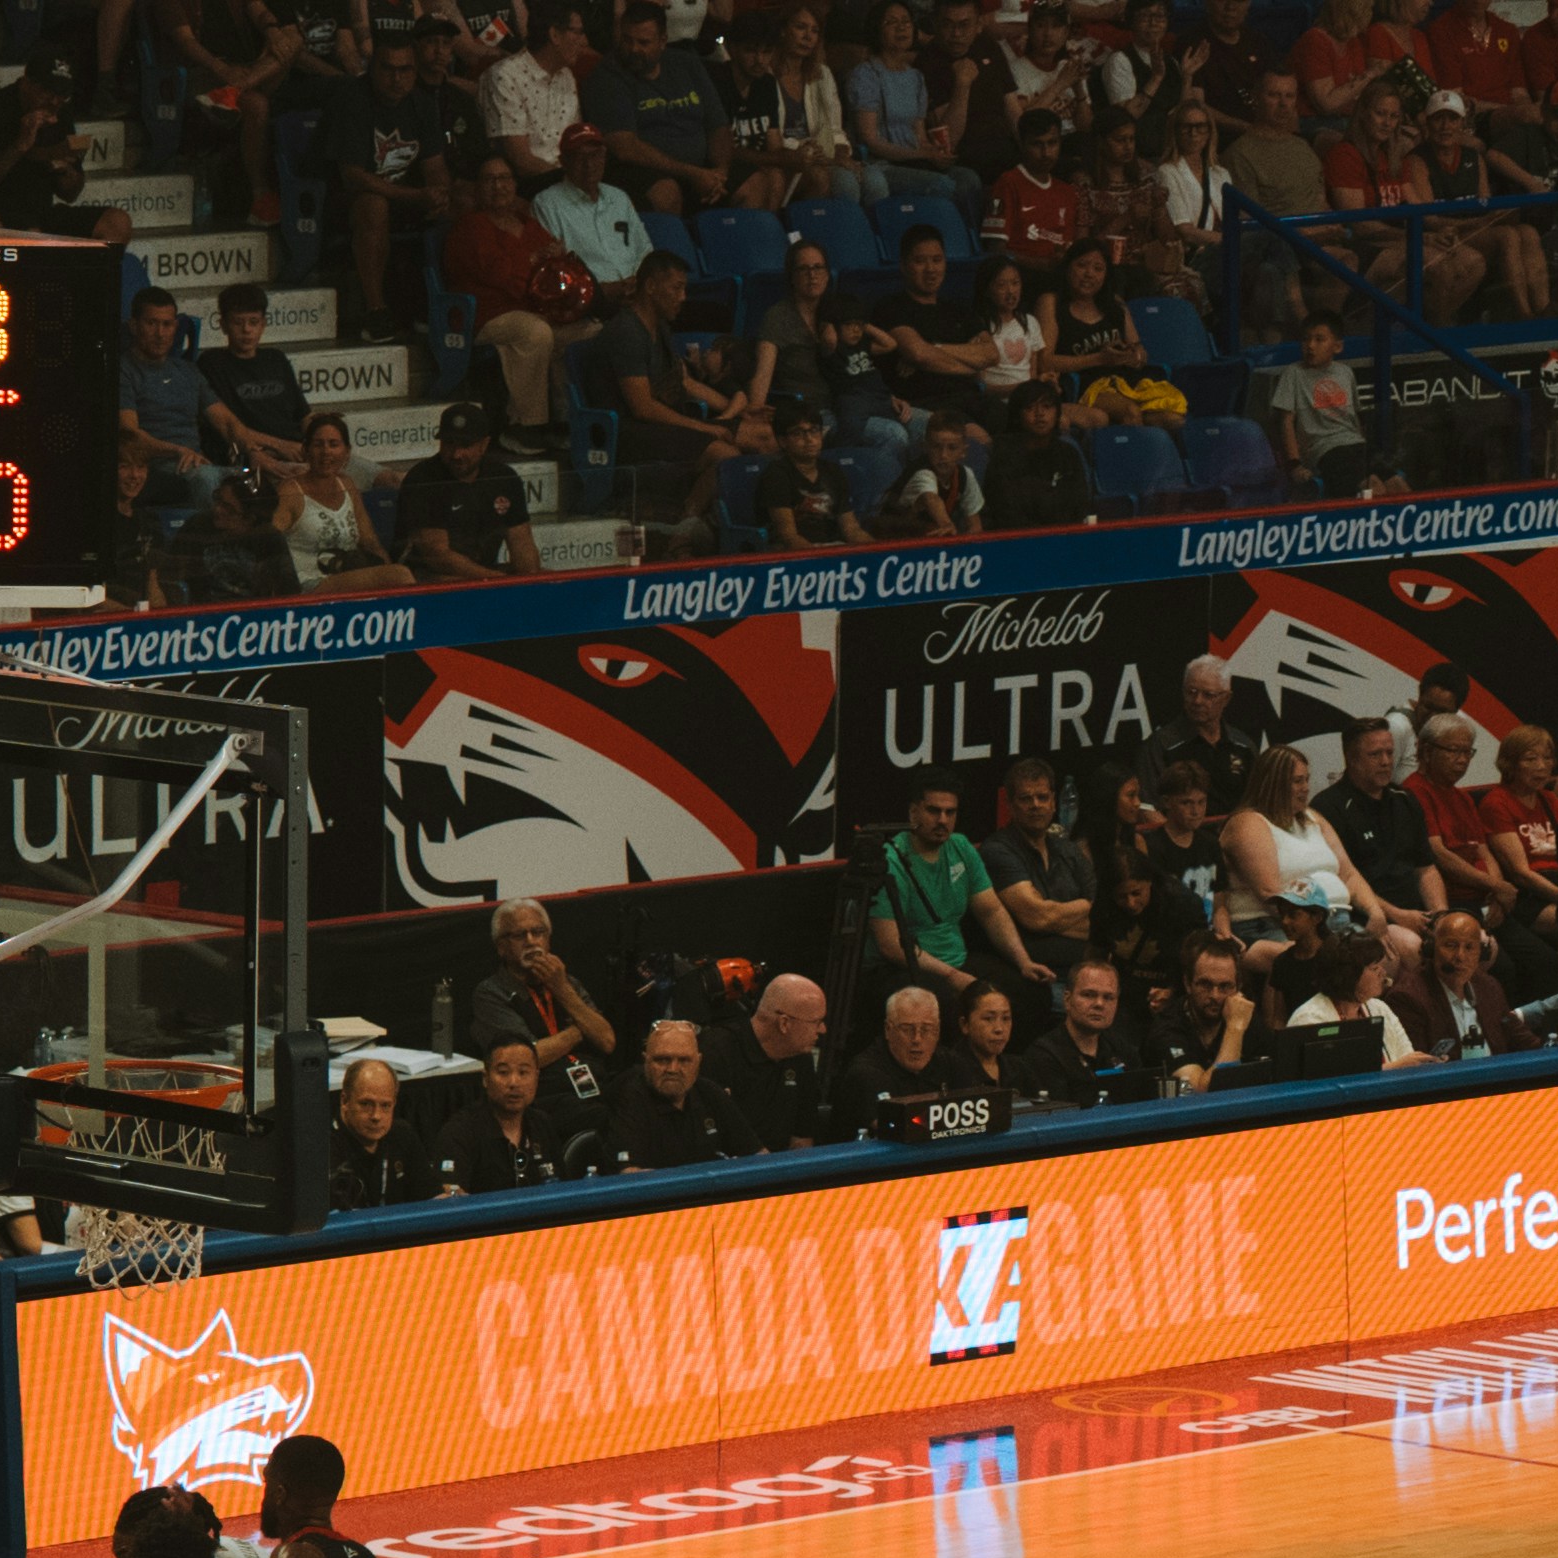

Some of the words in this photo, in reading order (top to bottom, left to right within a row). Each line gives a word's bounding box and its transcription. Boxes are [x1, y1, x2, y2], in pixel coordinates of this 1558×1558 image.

[157, 249, 253, 277] BROWN
[1072, 328, 1119, 356] CANAD
[300, 364, 393, 393] BROWN
[624, 576, 756, 623] Langley
[763, 560, 867, 610] Events
[876, 549, 983, 600] Centre
[923, 589, 1112, 665] Michelob
[883, 662, 1154, 769] ULTRA
[928, 1097, 991, 1133] POSS
[476, 1228, 838, 1430] CANADA
[1029, 1174, 1261, 1345] GAME
[1179, 1404, 1352, 1435] CEBL
